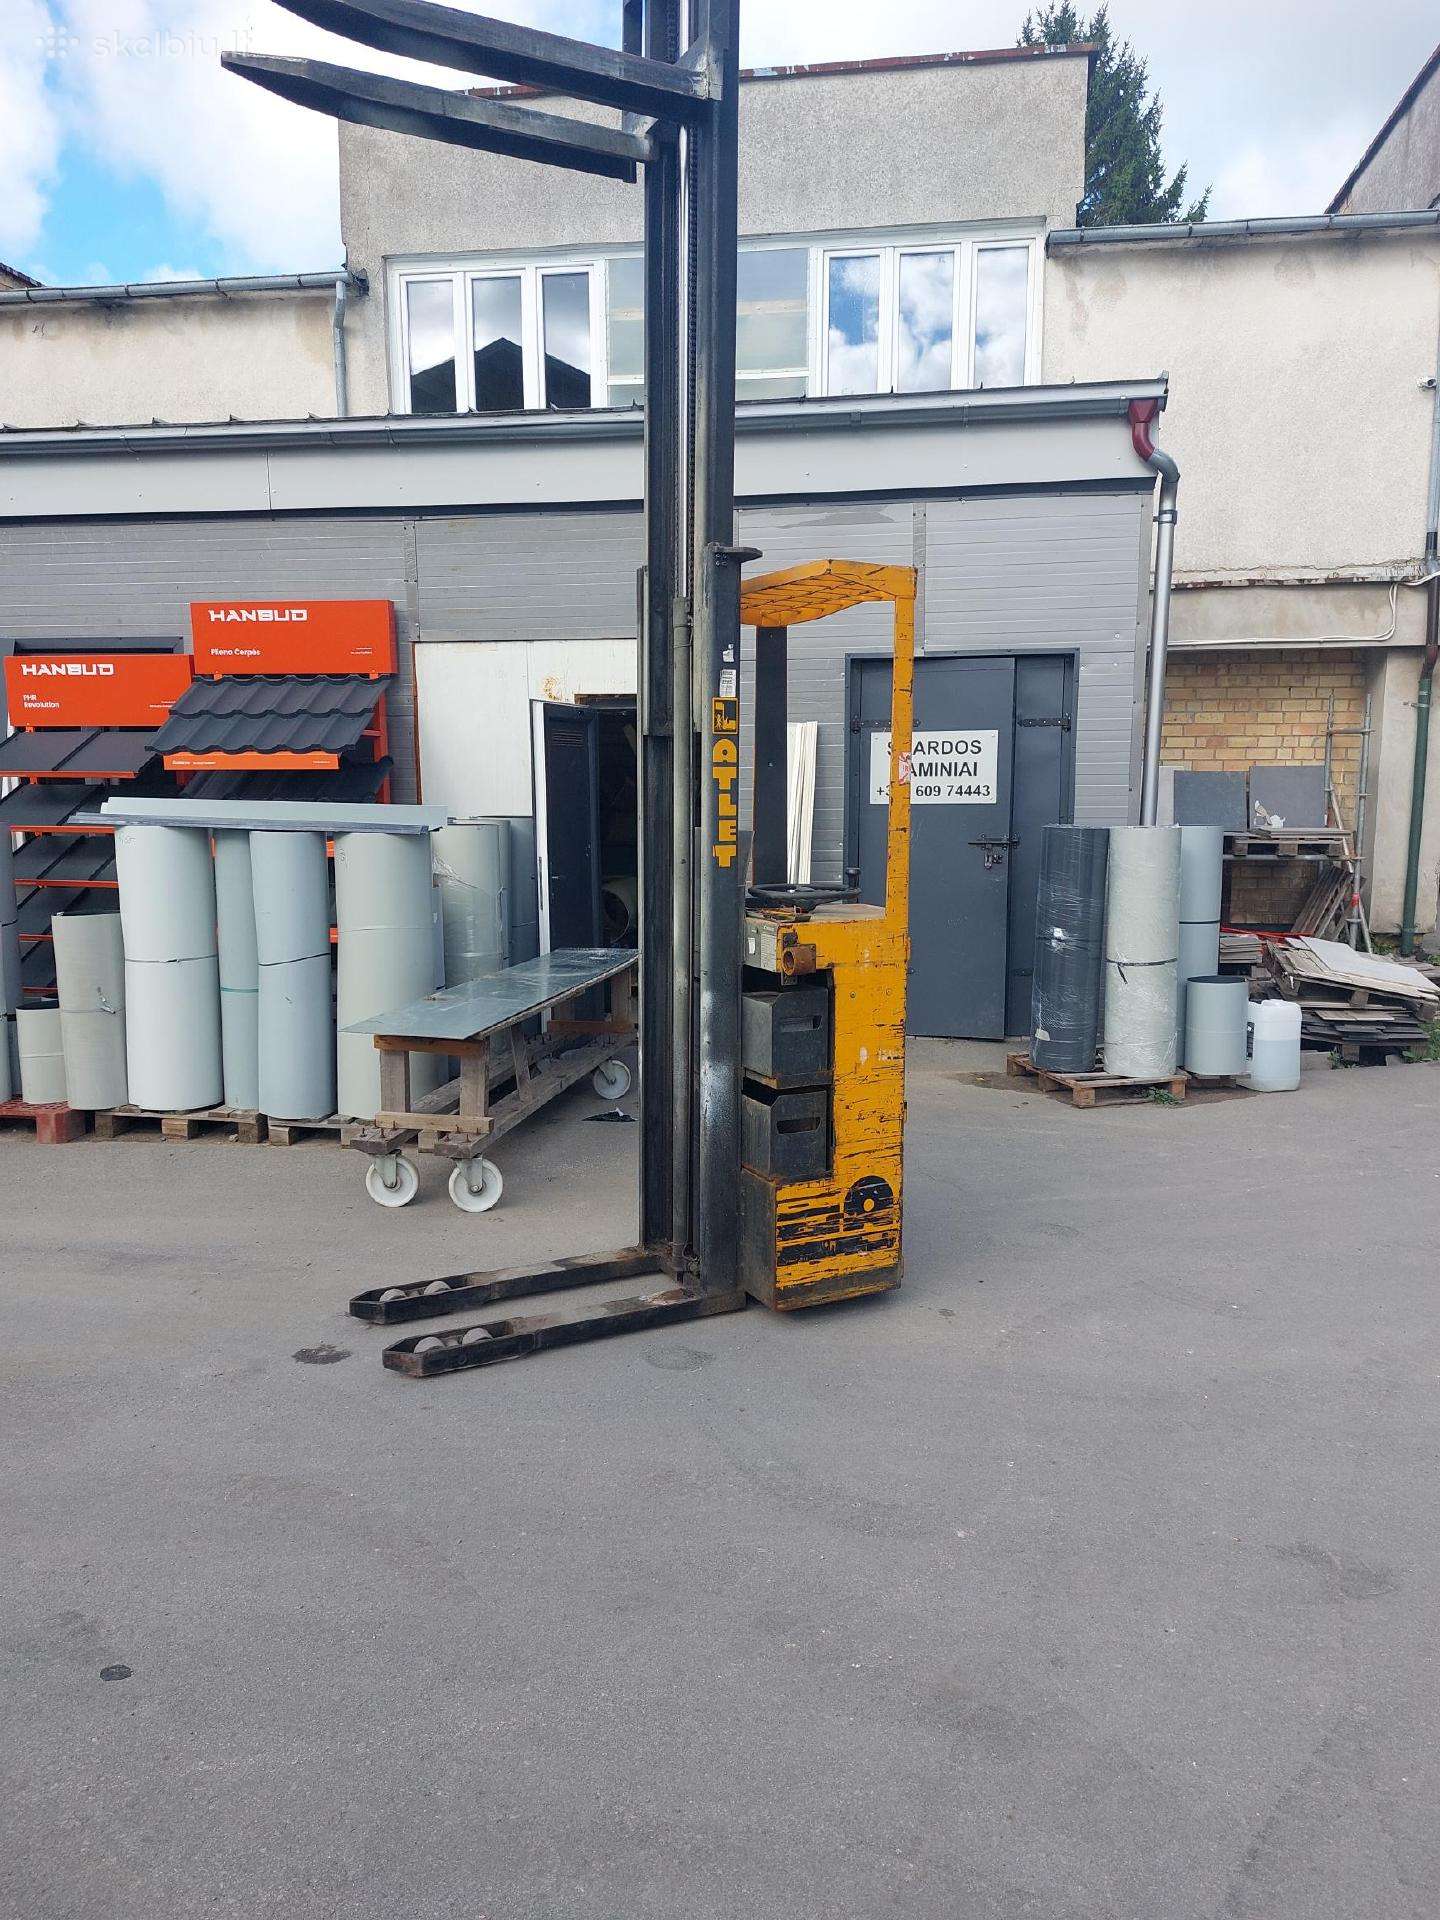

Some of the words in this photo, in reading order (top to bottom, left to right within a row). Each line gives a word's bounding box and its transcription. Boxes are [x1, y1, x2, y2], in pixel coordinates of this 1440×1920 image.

[208, 609, 308, 621] HANBUD
[21, 664, 114, 675] HANBUD
[888, 740, 982, 755] ARDOS
[910, 761, 978, 777] AMINIAI
[915, 785, 942, 797] 609
[947, 785, 991, 797] 74443
